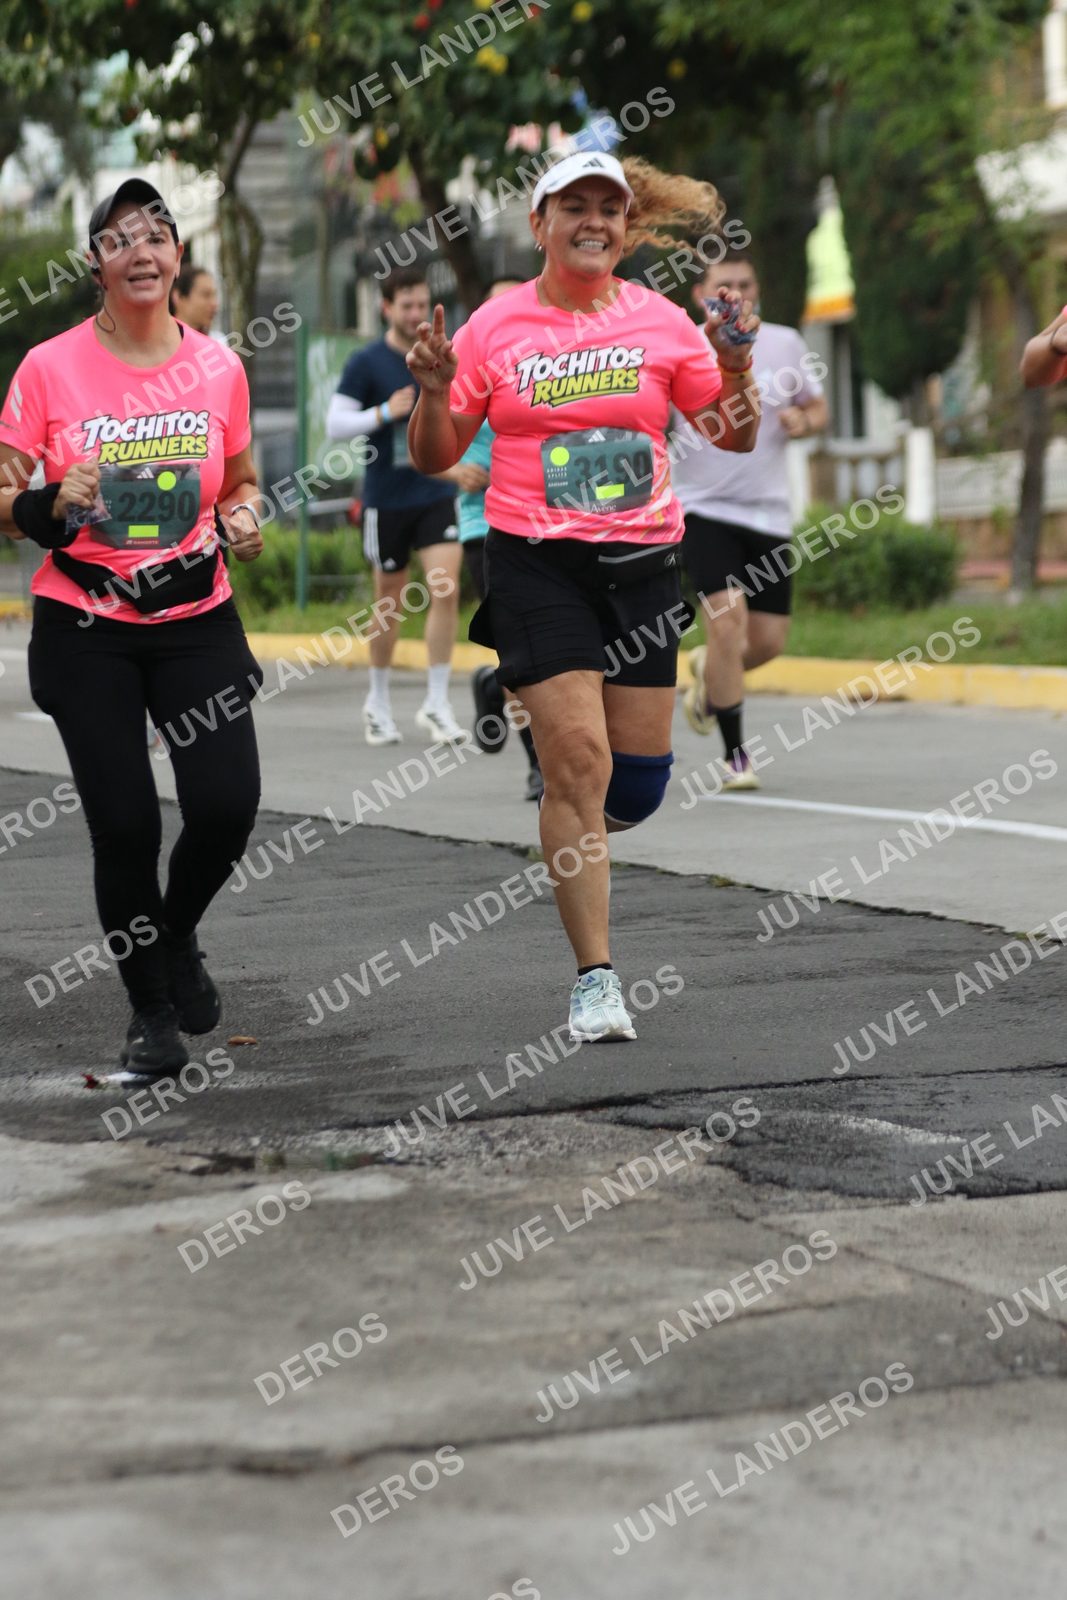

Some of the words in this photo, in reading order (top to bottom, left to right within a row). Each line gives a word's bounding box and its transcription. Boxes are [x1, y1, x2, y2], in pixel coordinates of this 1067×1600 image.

[516, 345, 645, 394] TOCHITOS
[530, 368, 638, 407] RUNNERS
[82, 410, 210, 451] TOCHITOS
[98, 434, 209, 466] RUNNERS
[573, 448, 651, 489] 3190
[118, 489, 197, 522] 2290
